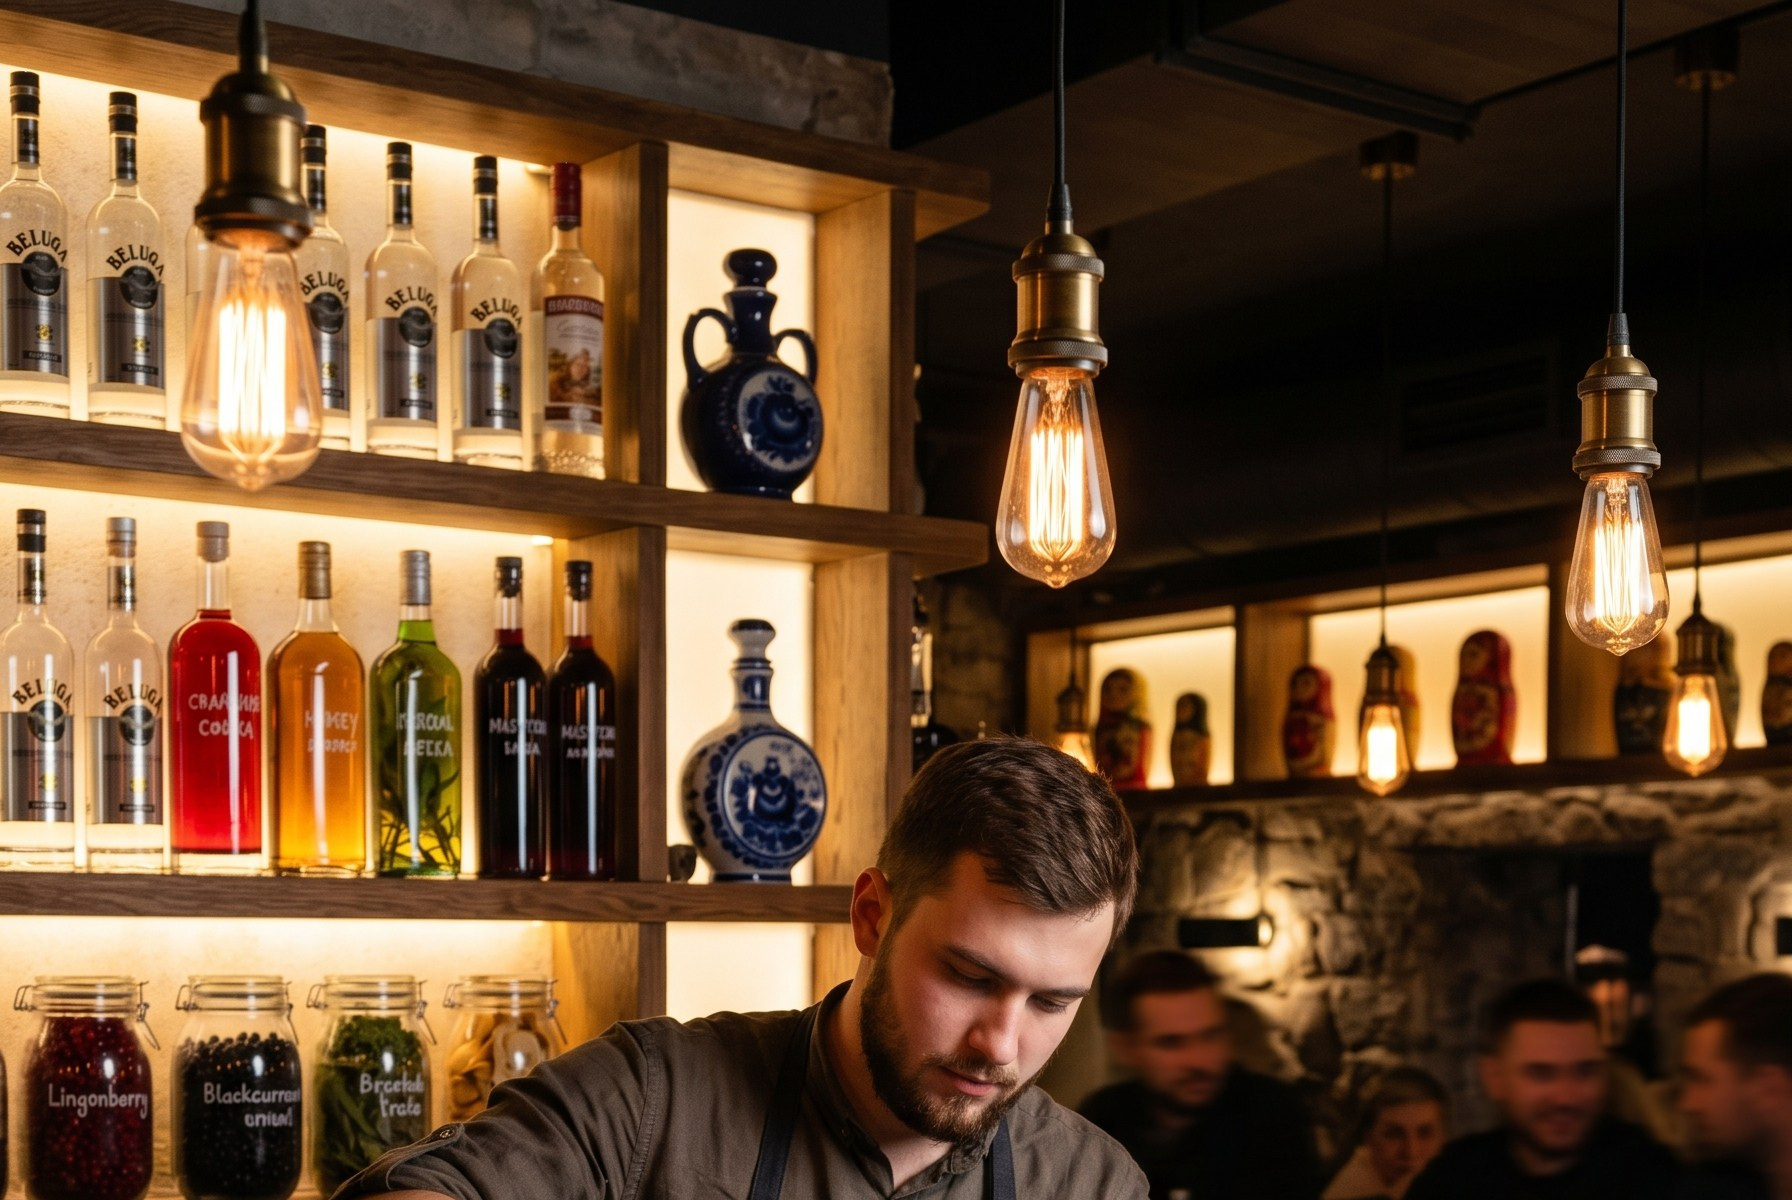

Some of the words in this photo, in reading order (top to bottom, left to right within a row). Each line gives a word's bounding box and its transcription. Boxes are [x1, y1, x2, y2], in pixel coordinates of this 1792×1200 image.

[6, 229, 68, 263] BELUGA
[106, 244, 165, 277] BELUGA
[385, 286, 438, 317] BELUGA
[470, 297, 522, 327] BELUGA
[48, 1083, 149, 1119] Lingonberry
